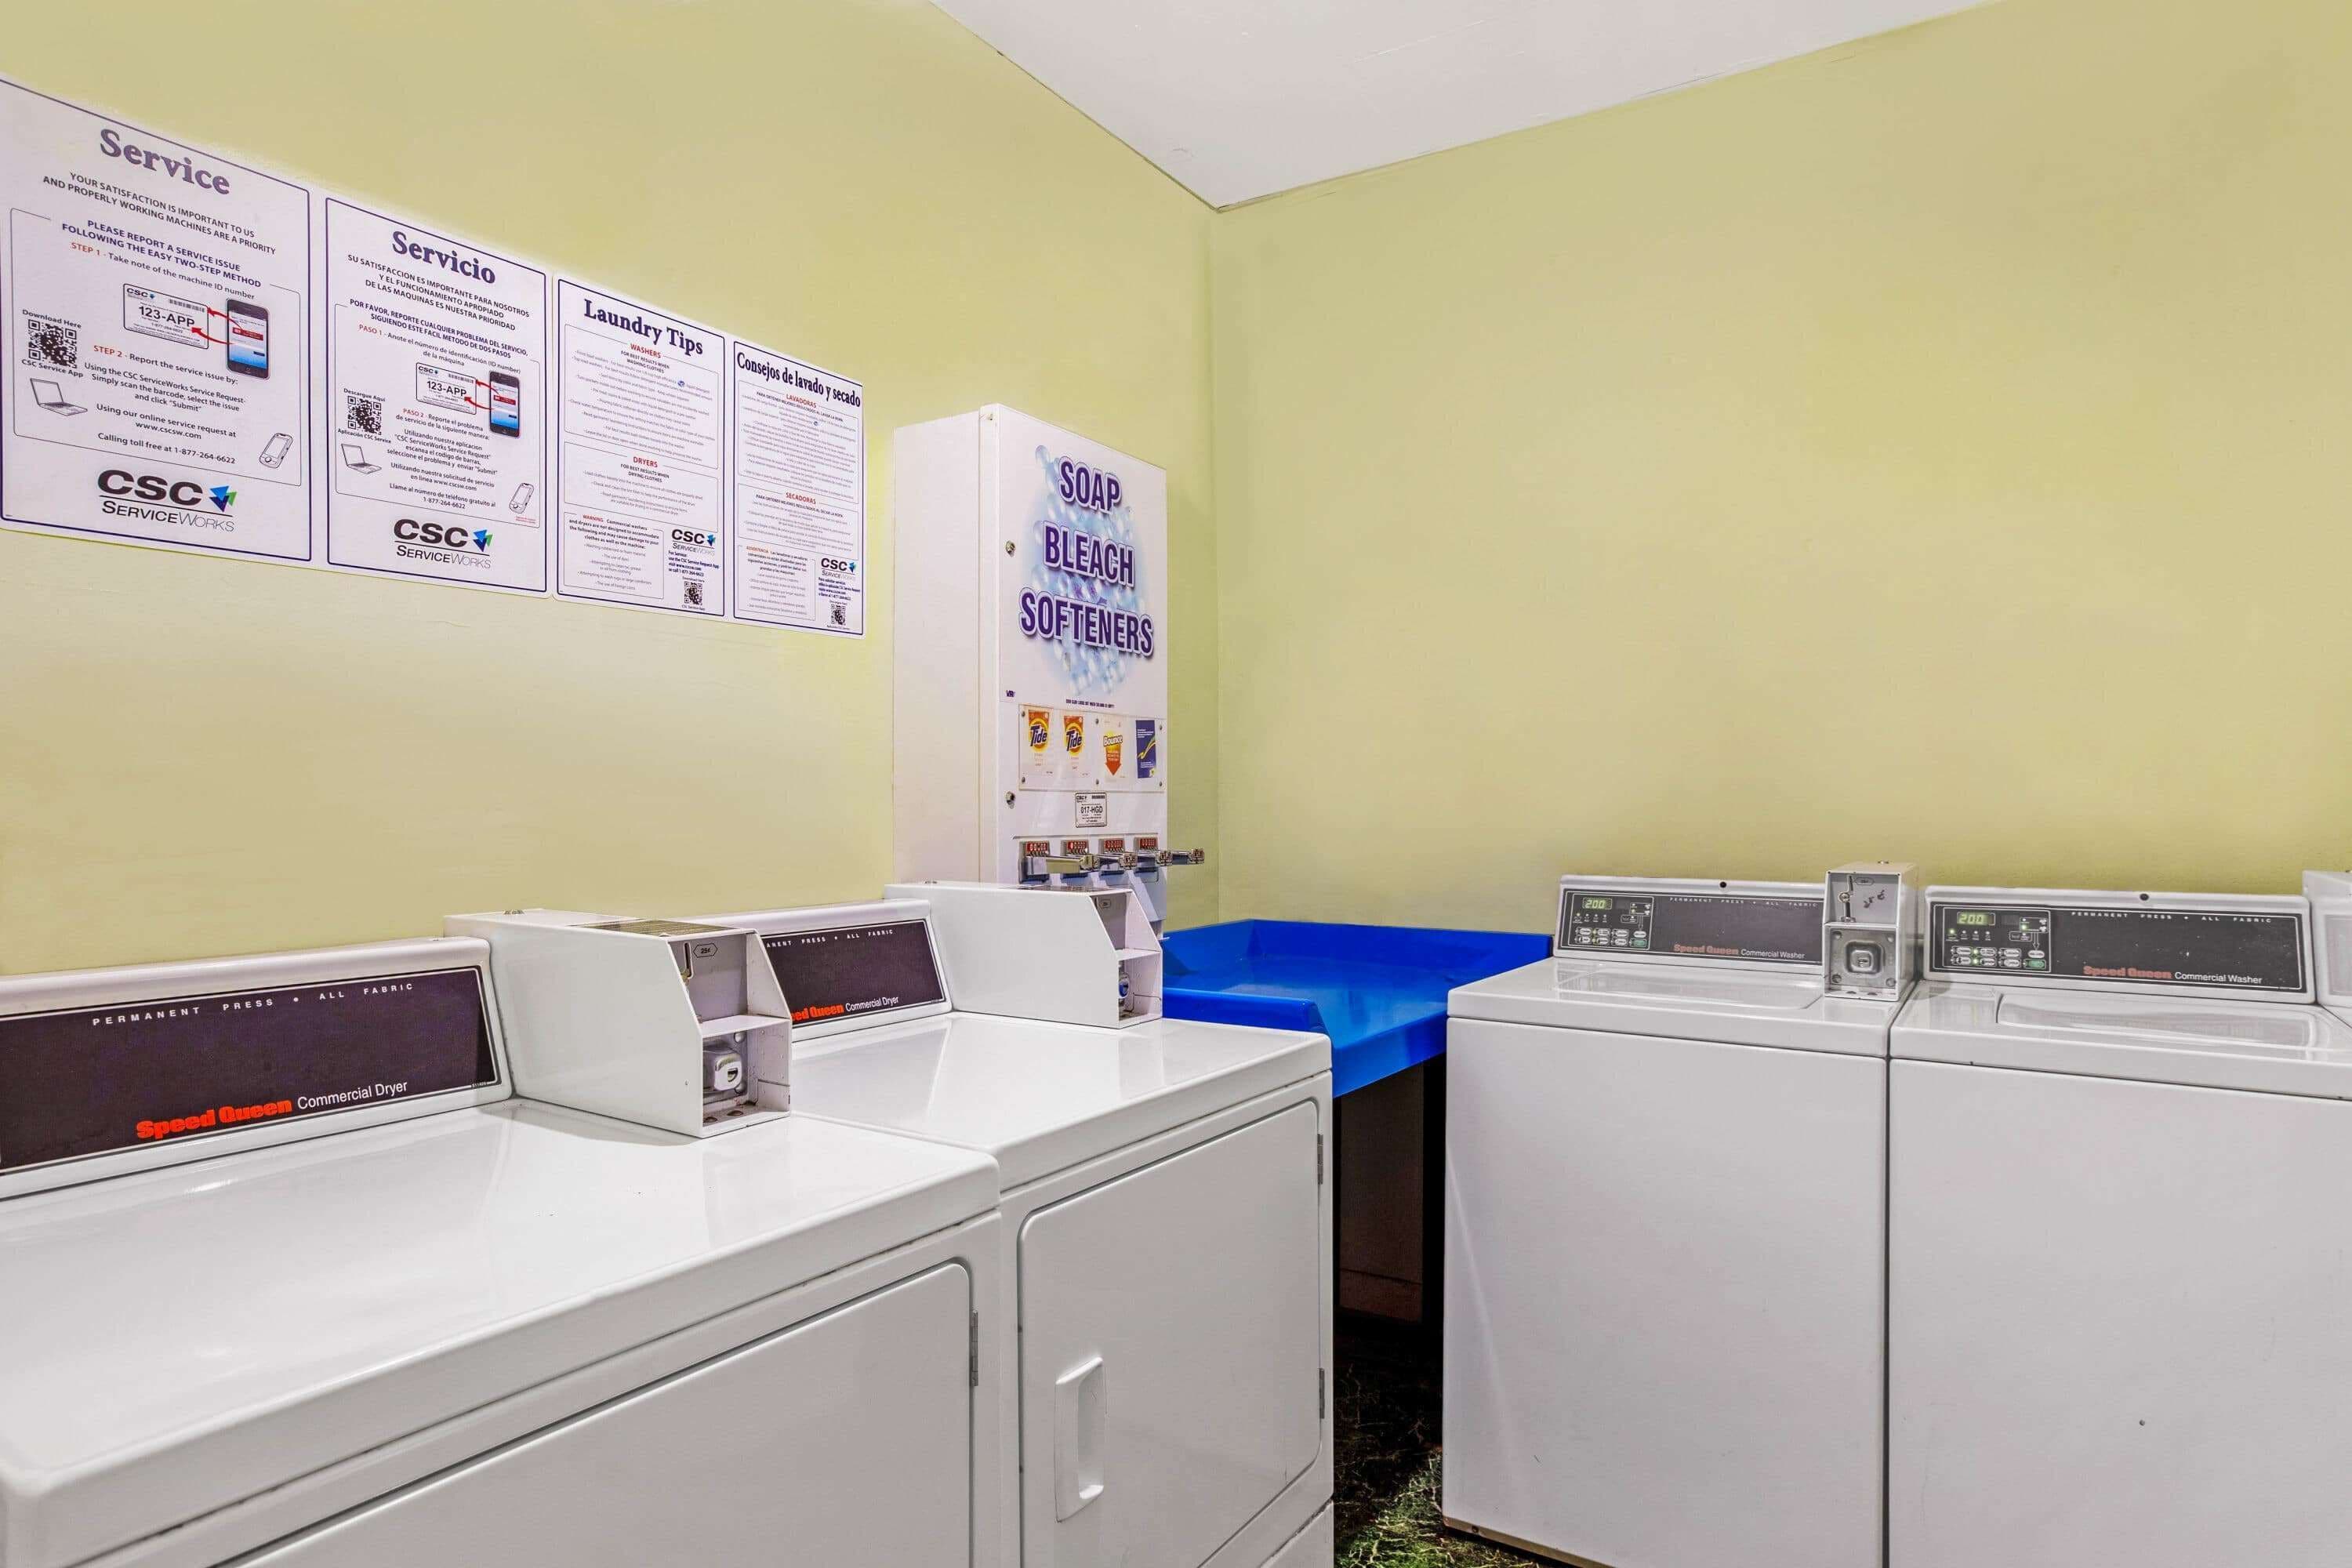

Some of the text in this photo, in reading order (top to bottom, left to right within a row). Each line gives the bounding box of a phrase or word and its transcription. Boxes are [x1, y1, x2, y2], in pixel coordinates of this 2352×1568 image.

[100, 128, 229, 194] Service
[42, 176, 65, 188] AND
[67, 183, 117, 205] PROPERLY
[119, 199, 164, 220] WORKING
[165, 214, 211, 234] MACHINES
[213, 230, 229, 241] ARE
[238, 237, 275, 254] PRIORITY
[69, 172, 254, 238] YOUR SATISFACTION IS IMPORTANT TO US
[61, 223, 261, 287] FOLLOWING THE EASY TWO-STEP METHOD
[87, 220, 125, 237] PLEASE
[126, 231, 165, 249] REPORT
[176, 246, 213, 263] SERVICE
[215, 258, 240, 271] ISSUE
[391, 230, 495, 284] Servicio
[71, 241, 93, 253] STEP
[107, 252, 129, 264] Take
[130, 260, 151, 270] note
[162, 268, 176, 278] the
[178, 274, 212, 288] machine
[224, 287, 254, 299] number
[138, 305, 195, 330] 123-APP
[583, 298, 702, 357] Laundry Tips
[93, 344, 114, 354] STEP
[129, 353, 158, 365] Report
[159, 360, 173, 369] the
[175, 365, 203, 376] service
[205, 371, 224, 381] issue
[630, 343, 661, 358] WASHERS
[84, 361, 107, 375] Using
[107, 368, 122, 376] the
[122, 370, 138, 380] CSC
[189, 385, 215, 397] Service
[91, 373, 118, 387] Simply
[187, 395, 208, 405] select
[426, 380, 466, 399] 123-APP
[736, 351, 860, 407] Consejos de lavado y secado
[786, 394, 816, 408] LAVADORAS
[97, 432, 128, 445] Calling
[129, 438, 143, 447] toll
[145, 441, 162, 450] free
[135, 422, 201, 439] www.cscsw.com
[633, 456, 658, 467] DRYERS
[97, 469, 203, 506] CSC
[785, 492, 816, 504] SECADORAS
[1059, 457, 1121, 513] SOAP
[394, 518, 468, 547] CSC
[671, 528, 705, 544] CSC
[820, 557, 848, 571] CSC
[1044, 521, 1134, 587] BLEACH
[1019, 587, 1153, 657] SOFTENERS
[1030, 724, 1047, 746] Tide
[1066, 729, 1082, 751] Tide
[1104, 735, 1123, 746] Bounce
[1584, 899, 1606, 909] 200
[1960, 913, 1984, 924] 200
[1673, 943, 1705, 953] Speed
[1706, 945, 1739, 955] Queen
[1740, 949, 1779, 958] Commercial
[2083, 965, 2263, 984] Speed Queen Commercial Washer
[93, 982, 414, 1026] PERMANENT PRESS ALL FABRIC
[809, 1004, 844, 1018] Queen
[845, 997, 882, 1012] Commercial
[882, 996, 899, 1007] Dryer
[136, 1080, 408, 1140] Speed Queen Commercial Dryer
